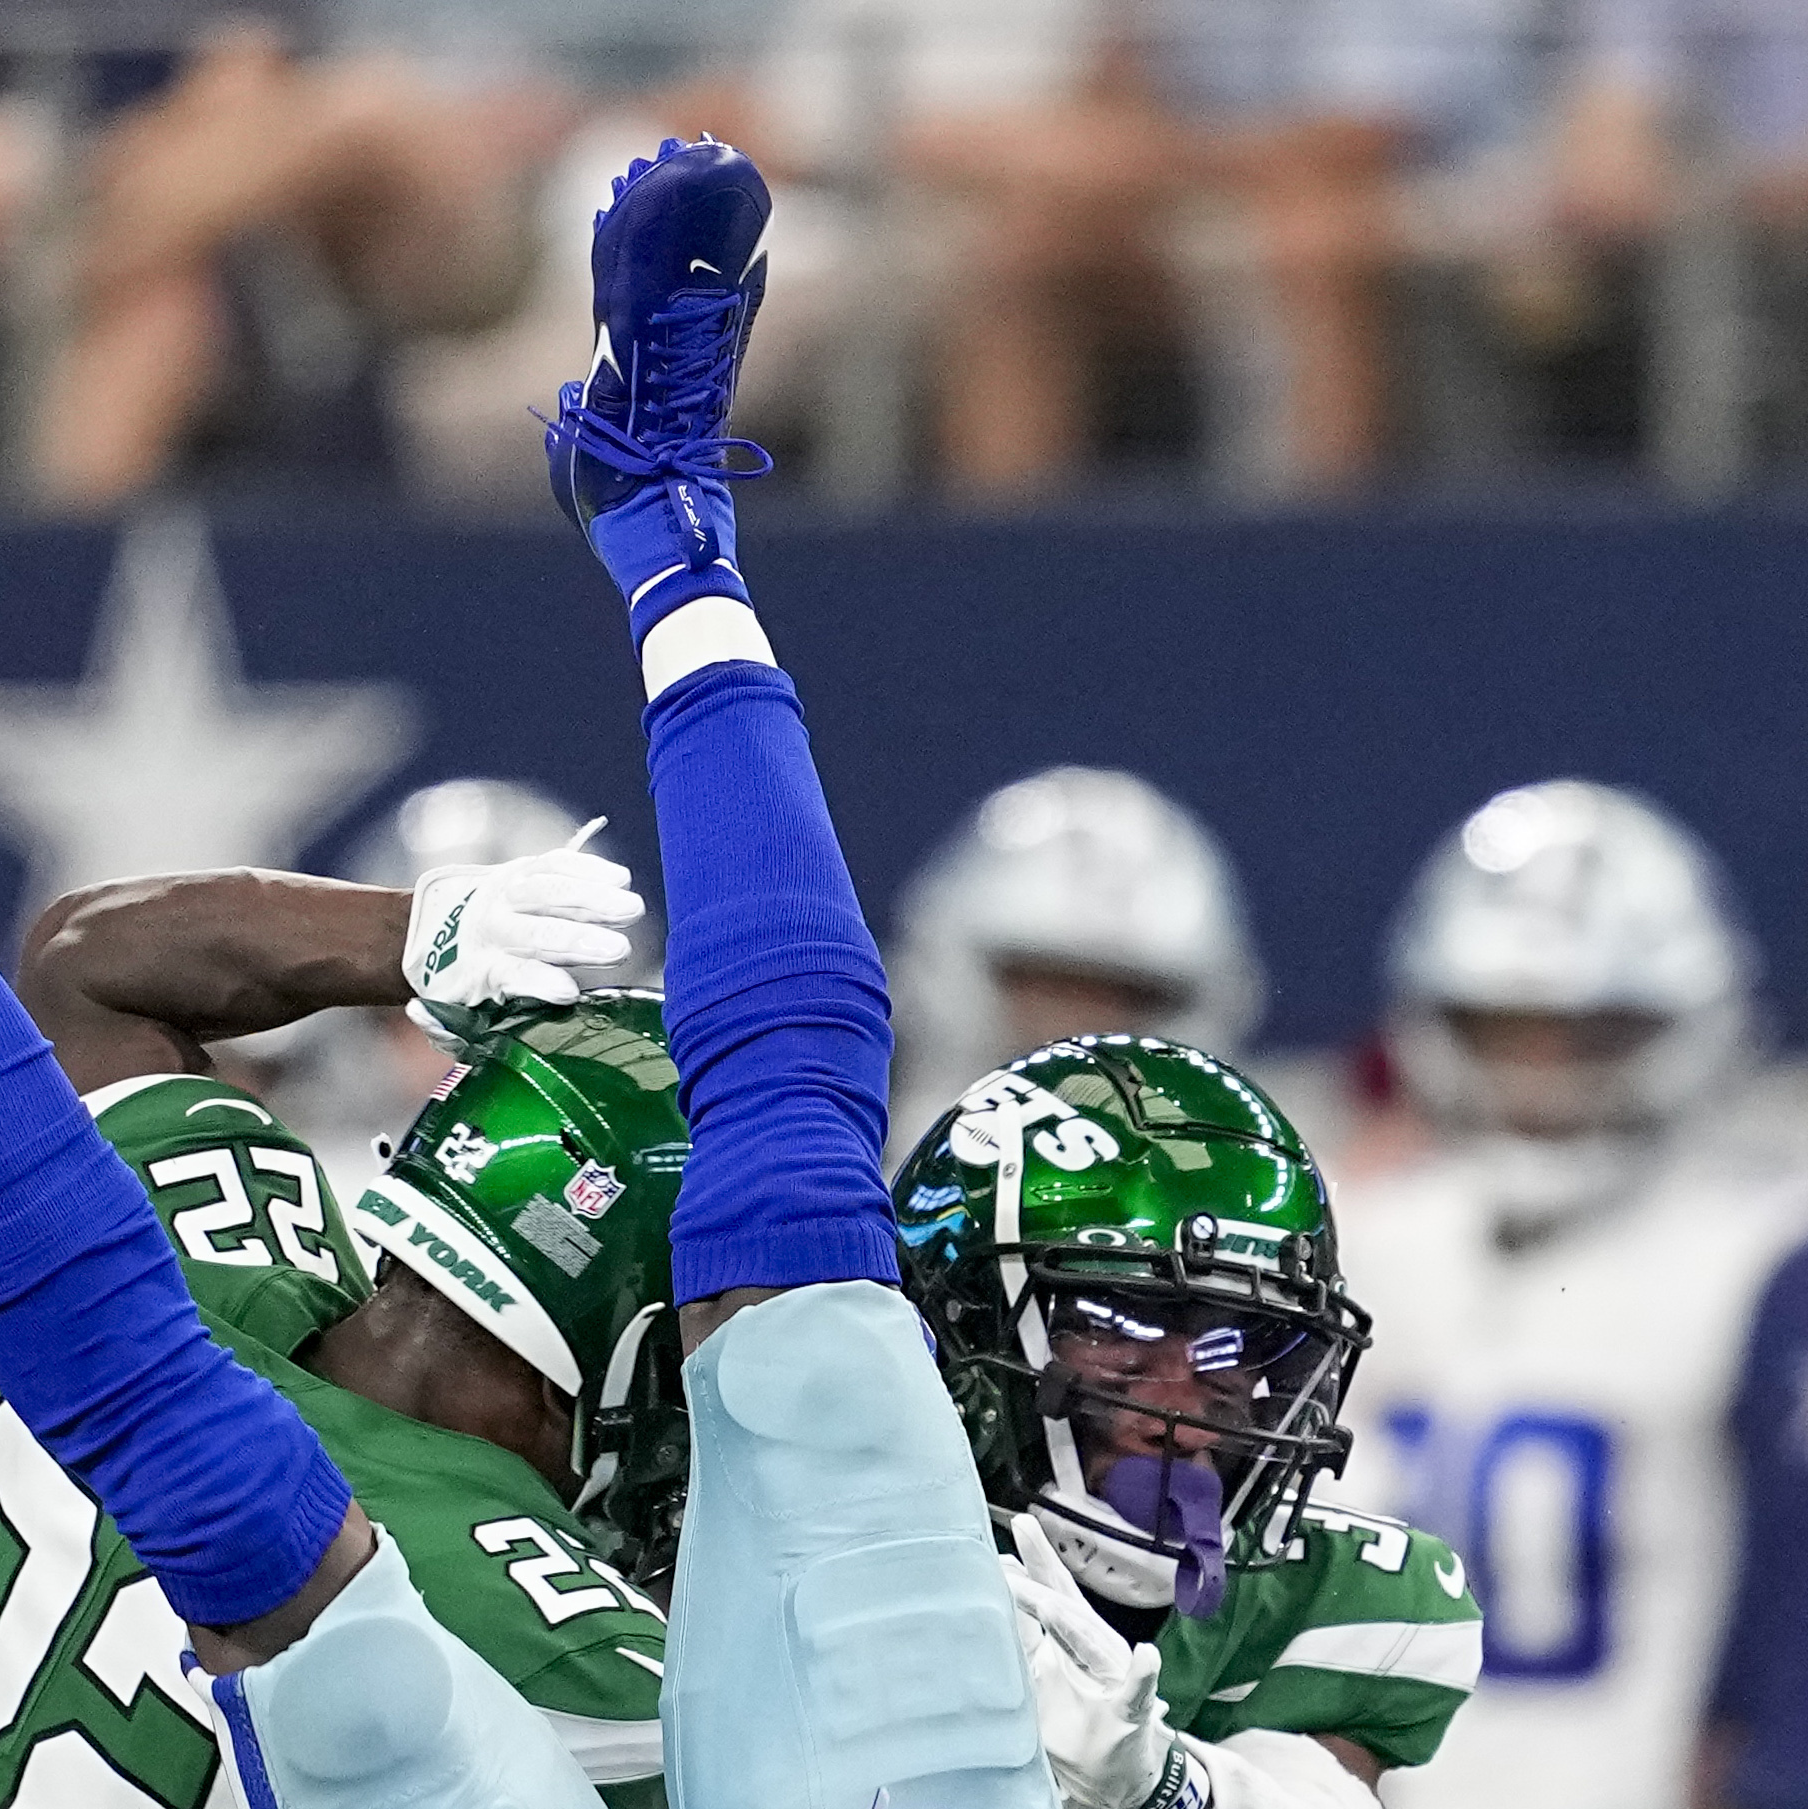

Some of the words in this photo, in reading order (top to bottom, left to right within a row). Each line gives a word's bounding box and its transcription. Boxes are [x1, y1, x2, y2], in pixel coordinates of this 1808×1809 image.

[145, 1145, 341, 1286] 22
[570, 1178, 606, 1213] NFL
[406, 1221, 519, 1315] YORK
[1160, 1750, 1185, 1798] Built
